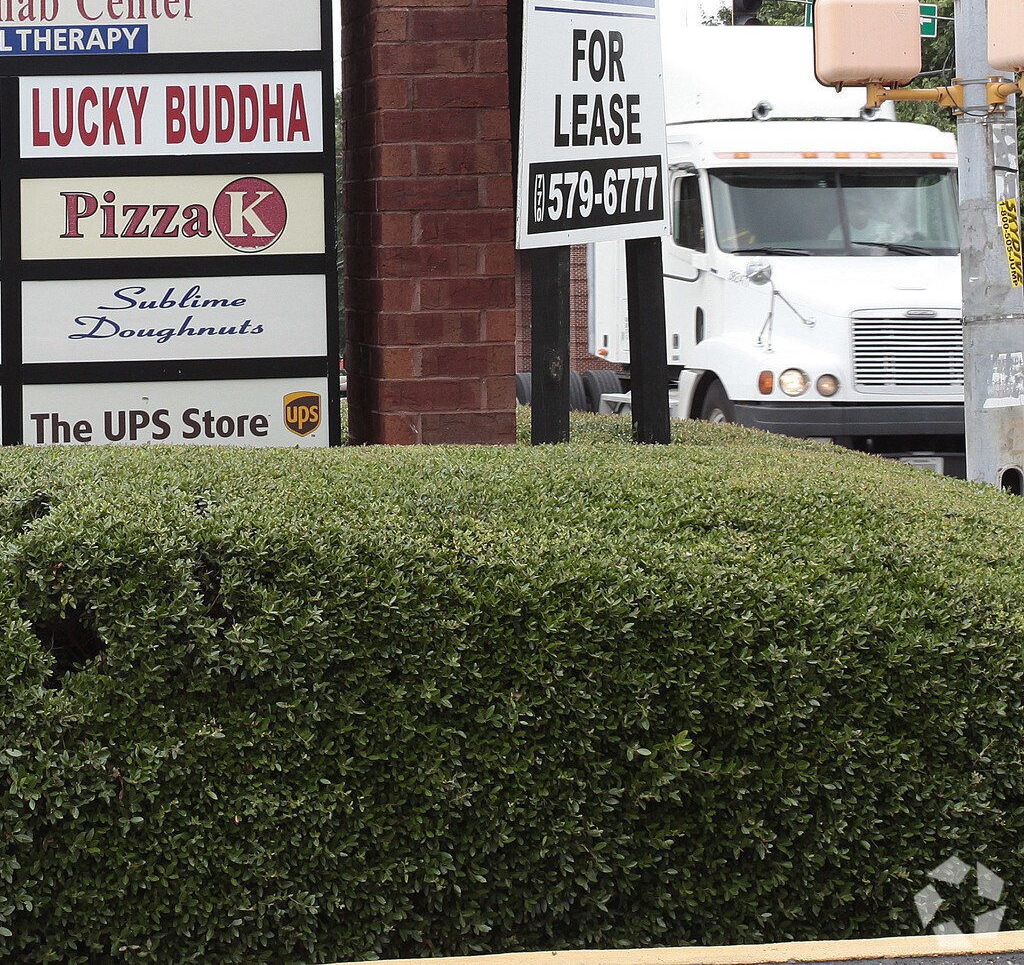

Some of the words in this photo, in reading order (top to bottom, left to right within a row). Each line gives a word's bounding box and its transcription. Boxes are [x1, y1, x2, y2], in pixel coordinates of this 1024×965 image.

[18, 27, 140, 50] THERAPY
[573, 29, 626, 83] FOR
[32, 86, 150, 147] LUCKY
[166, 83, 311, 145] BUDDHA
[555, 93, 642, 148] LEASE
[59, 191, 212, 239] Pizza
[534, 174, 545, 222] (770)
[548, 167, 658, 221] 579-6777
[999, 201, 1018, 287] 1-800-505-JUMP
[97, 285, 248, 311] Sublime
[68, 315, 265, 343] Doughnuts
[31, 413, 93, 444] The
[104, 409, 171, 441] UPS
[182, 408, 268, 439] Store
[286, 405, 319, 429] ups
